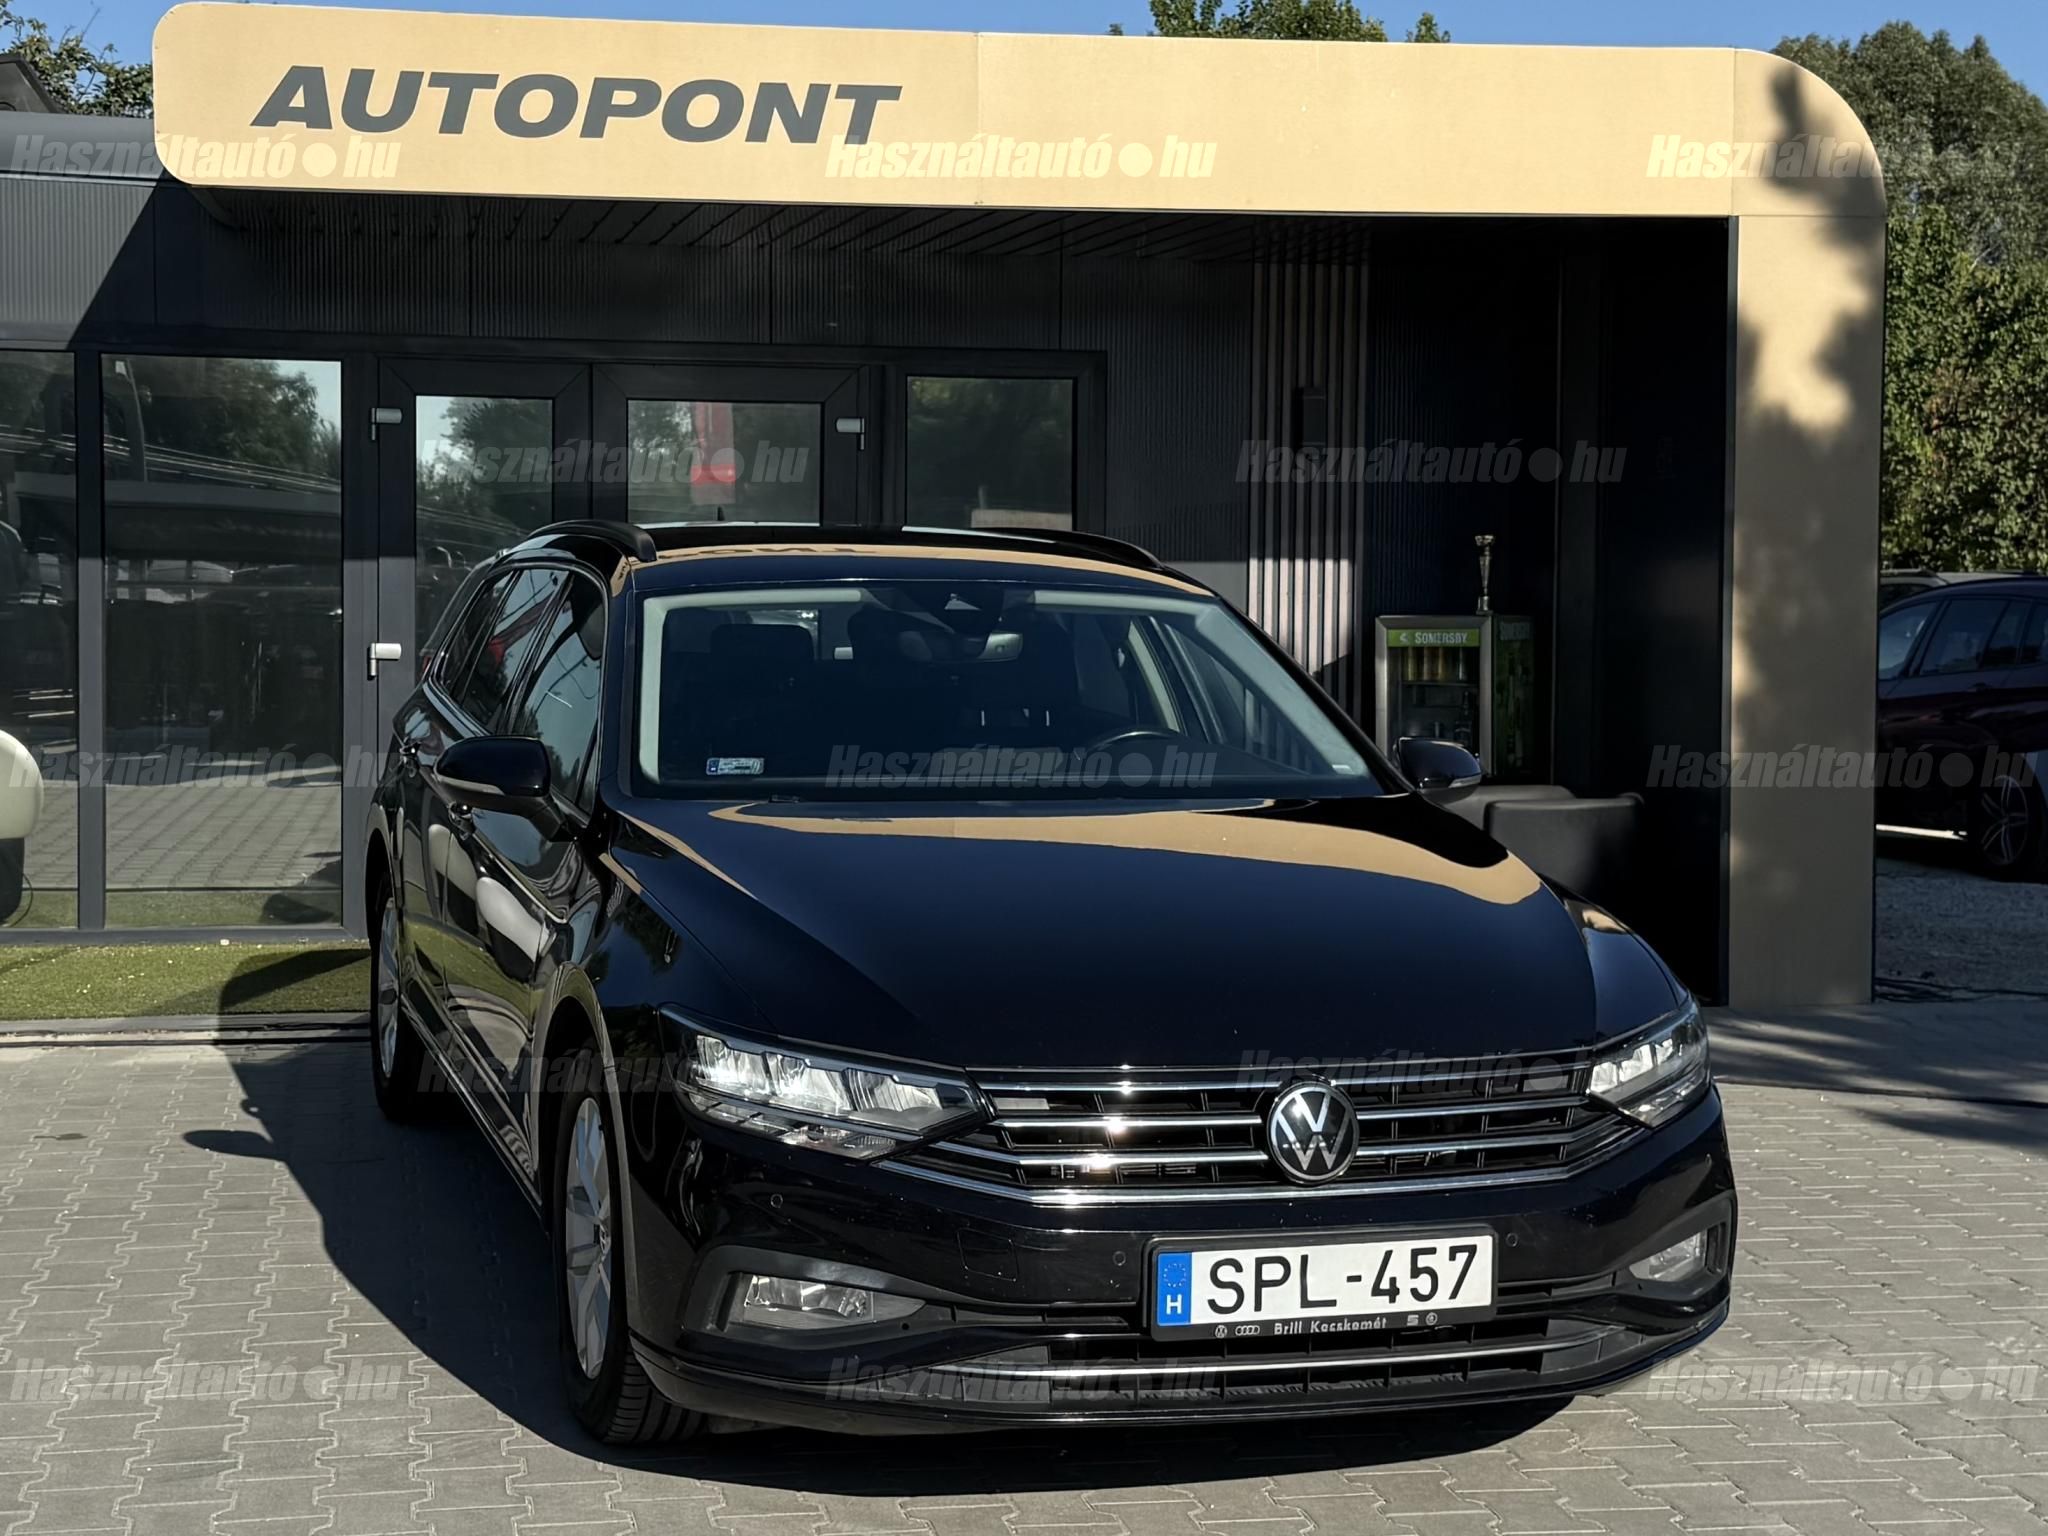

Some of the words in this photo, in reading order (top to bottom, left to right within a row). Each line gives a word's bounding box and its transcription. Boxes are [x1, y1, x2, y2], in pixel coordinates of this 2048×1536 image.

[250, 65, 903, 145] AUTOPONT
[1415, 632, 1468, 644] SOMERSBY
[1207, 1244, 1478, 1315] SPL-457
[1165, 1294, 1183, 1316] H
[1273, 1321, 1302, 1336] Brill
